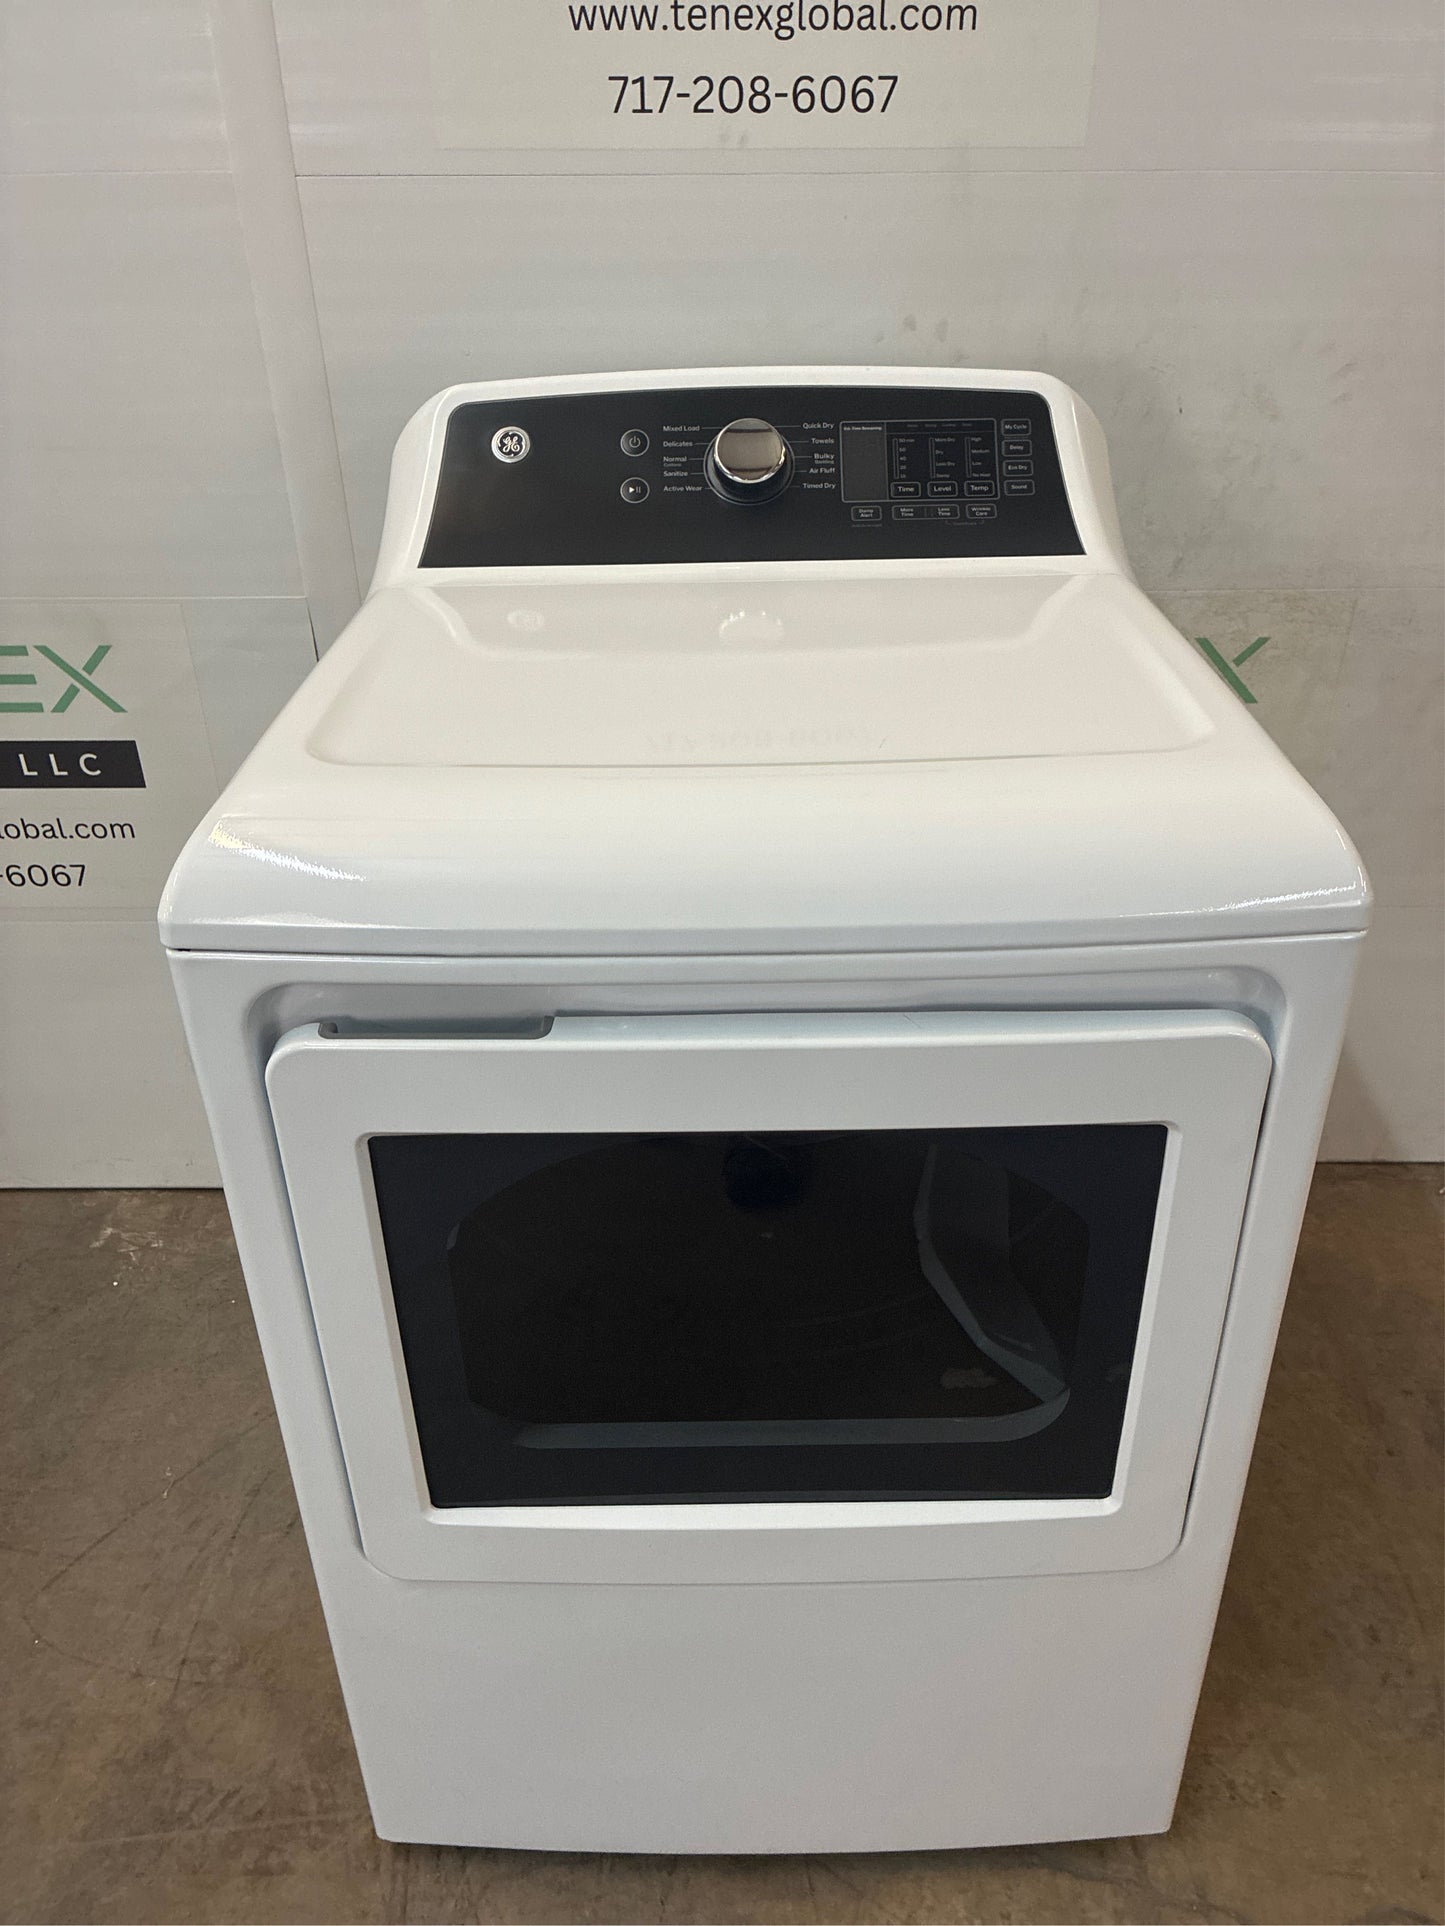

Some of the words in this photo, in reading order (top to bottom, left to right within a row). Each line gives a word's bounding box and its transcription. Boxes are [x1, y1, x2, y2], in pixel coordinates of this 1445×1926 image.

[568, 0, 978, 41] www.tenexglobal.com
[608, 75, 899, 114] 717-208-6067
[814, 452, 835, 460] Bulky
[824, 482, 837, 490] Dry
[18, 752, 102, 777] LLC
[0, 817, 136, 839] obal.com
[0, 864, 86, 887] 6067
